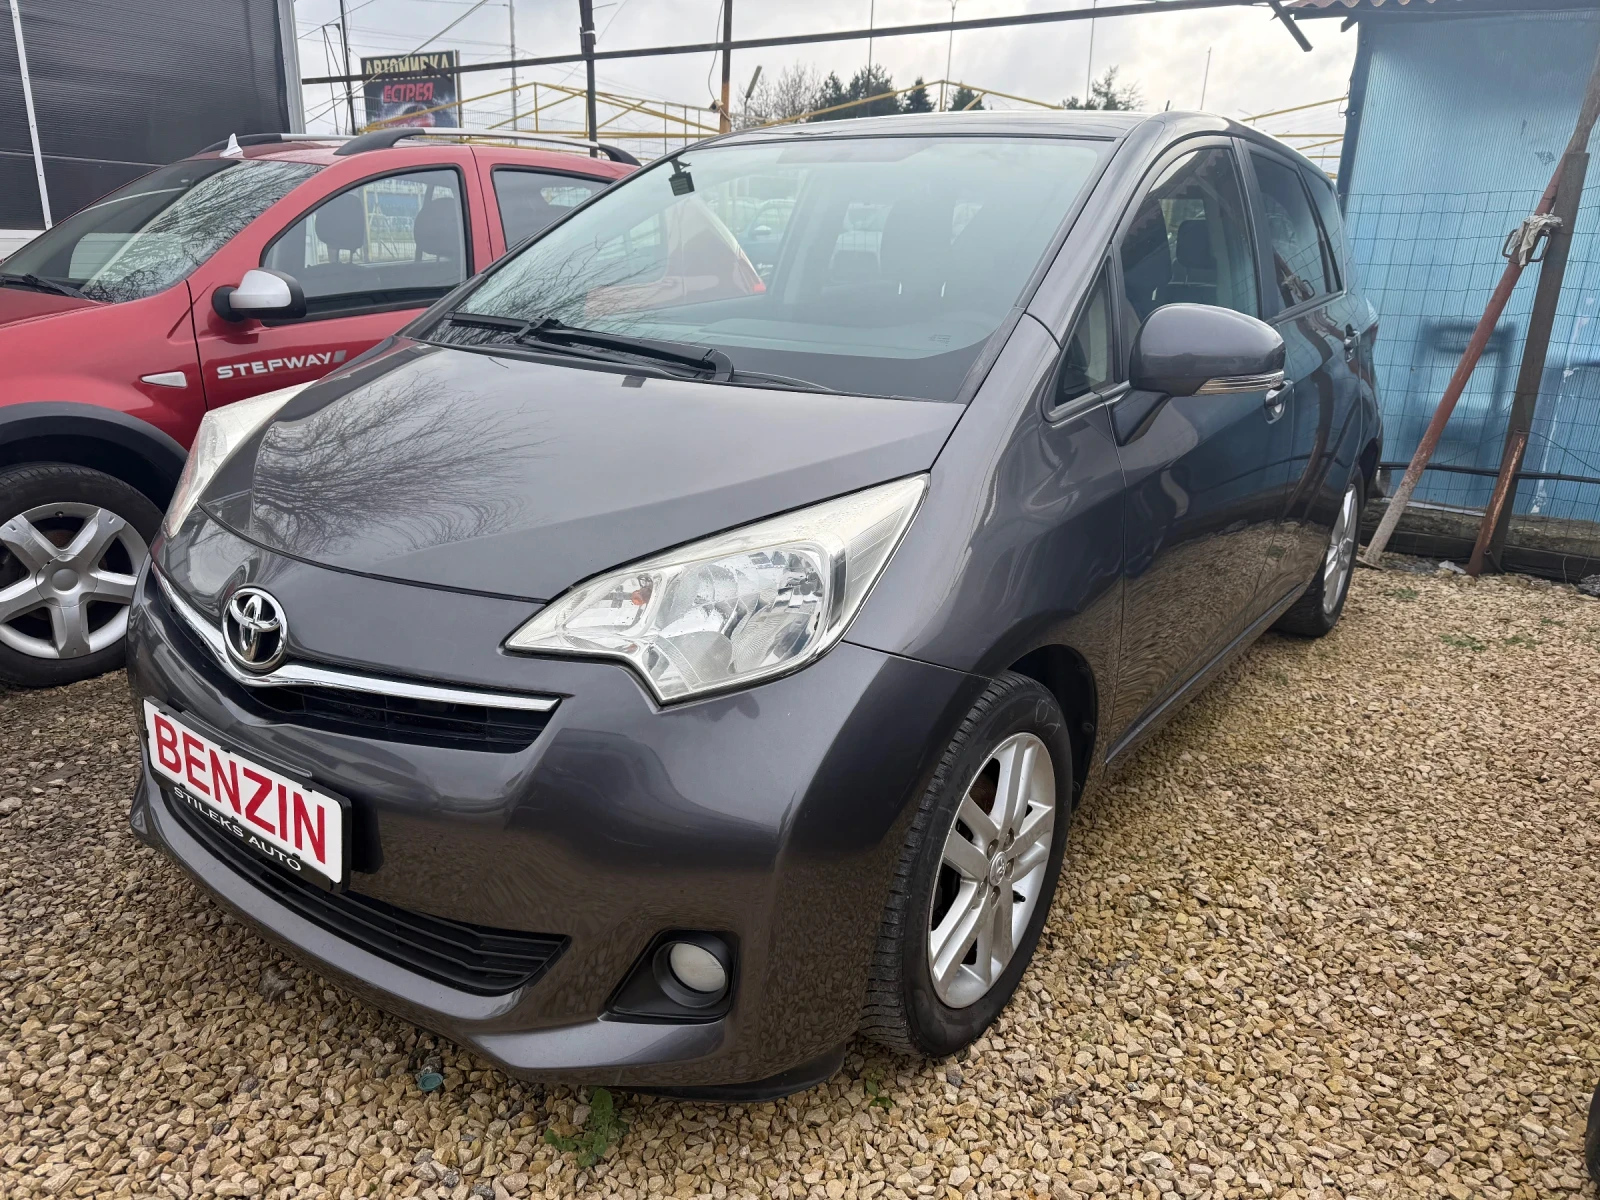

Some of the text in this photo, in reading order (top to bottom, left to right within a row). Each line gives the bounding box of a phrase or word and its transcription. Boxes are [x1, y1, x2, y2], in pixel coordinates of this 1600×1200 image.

[364, 54, 451, 82] АВТОМИВКА
[383, 82, 434, 104] ЕСТРЕЯ
[216, 352, 332, 379] STEPWAY
[153, 713, 326, 865] BENZIN
[173, 786, 302, 871] STILEKS AUTO
